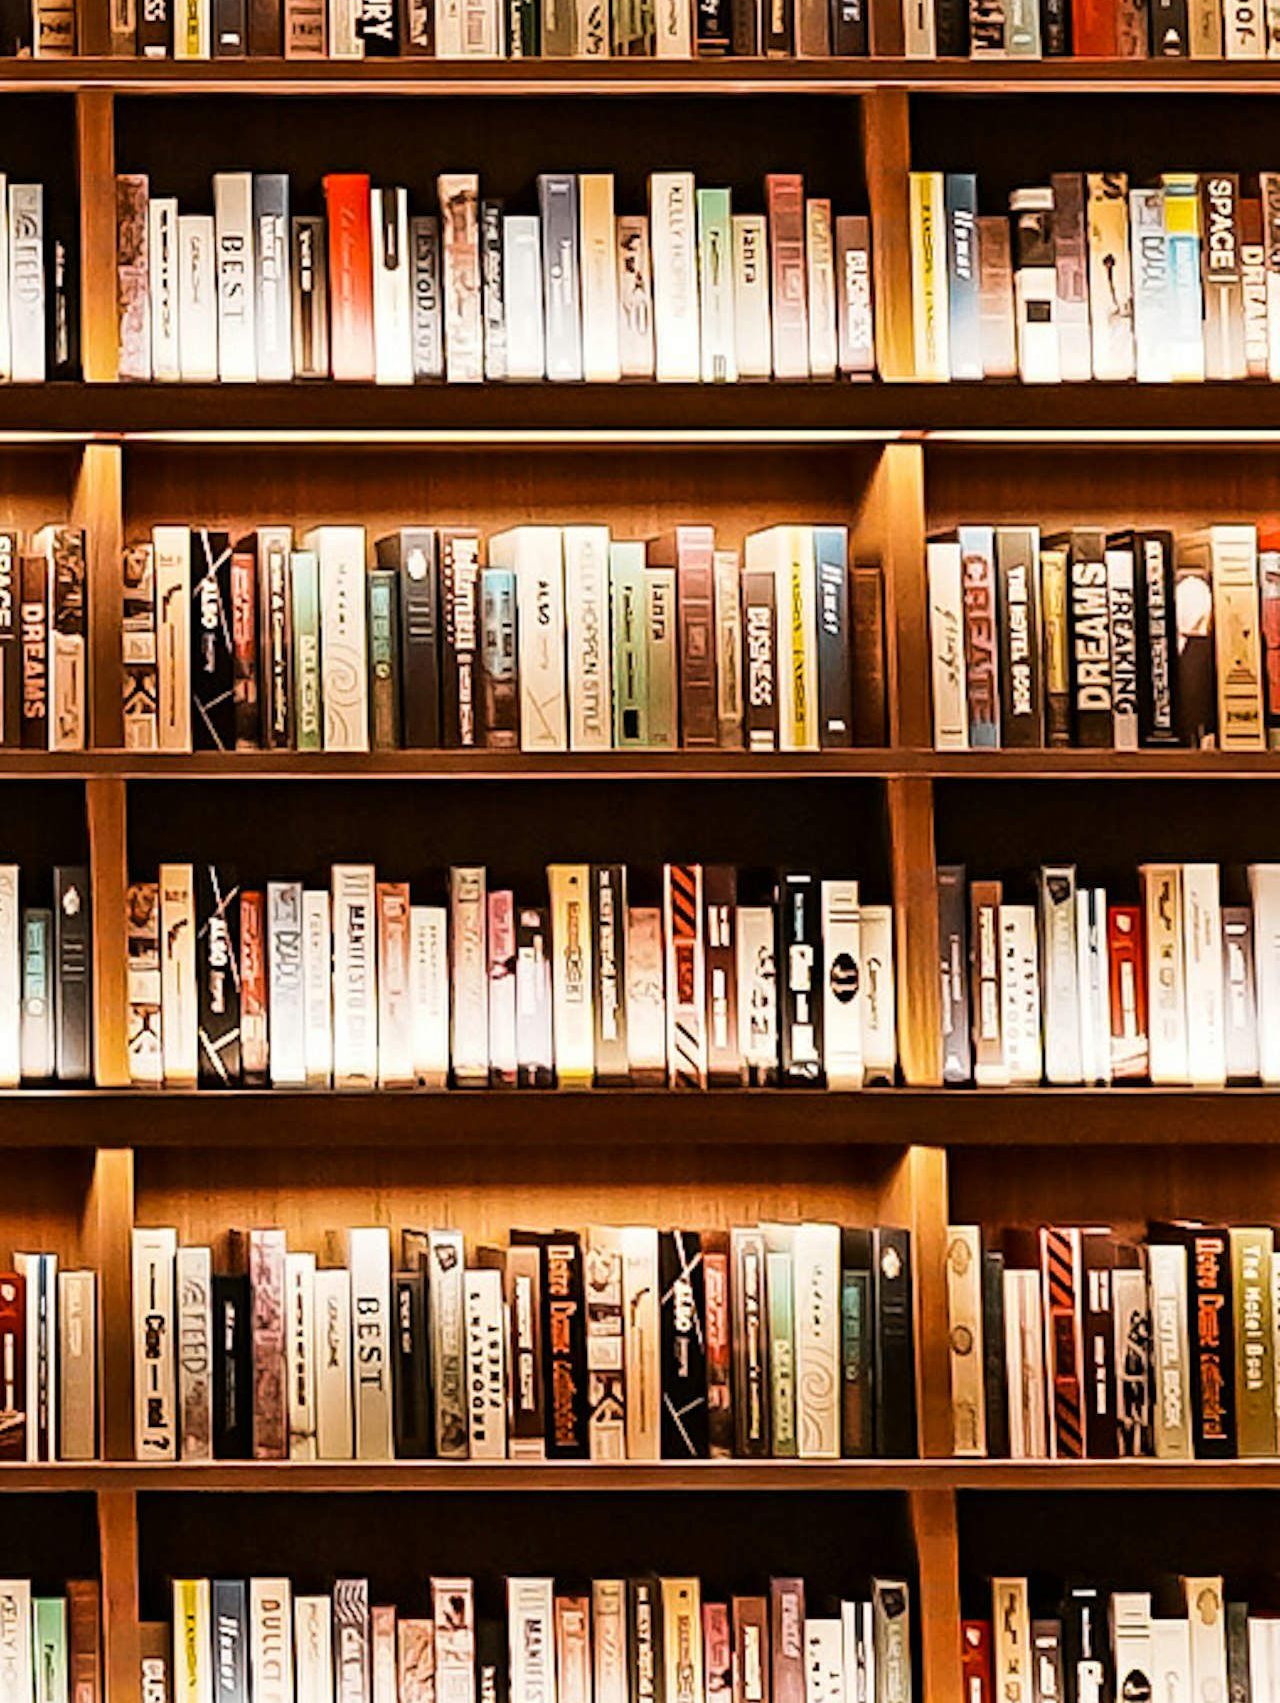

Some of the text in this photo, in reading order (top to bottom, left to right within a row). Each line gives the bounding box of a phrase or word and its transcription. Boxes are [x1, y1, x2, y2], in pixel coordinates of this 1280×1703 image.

[1209, 180, 1231, 267] SPACE
[222, 236, 243, 322] BEST
[21, 603, 44, 718] DREAMS
[749, 607, 772, 705] BUSINESS
[964, 554, 993, 724] CREATE
[1072, 564, 1110, 709] DREAMS
[1111, 588, 1135, 714] FREAKING
[1242, 1246, 1262, 1278] The
[357, 1296, 382, 1392] BEST
